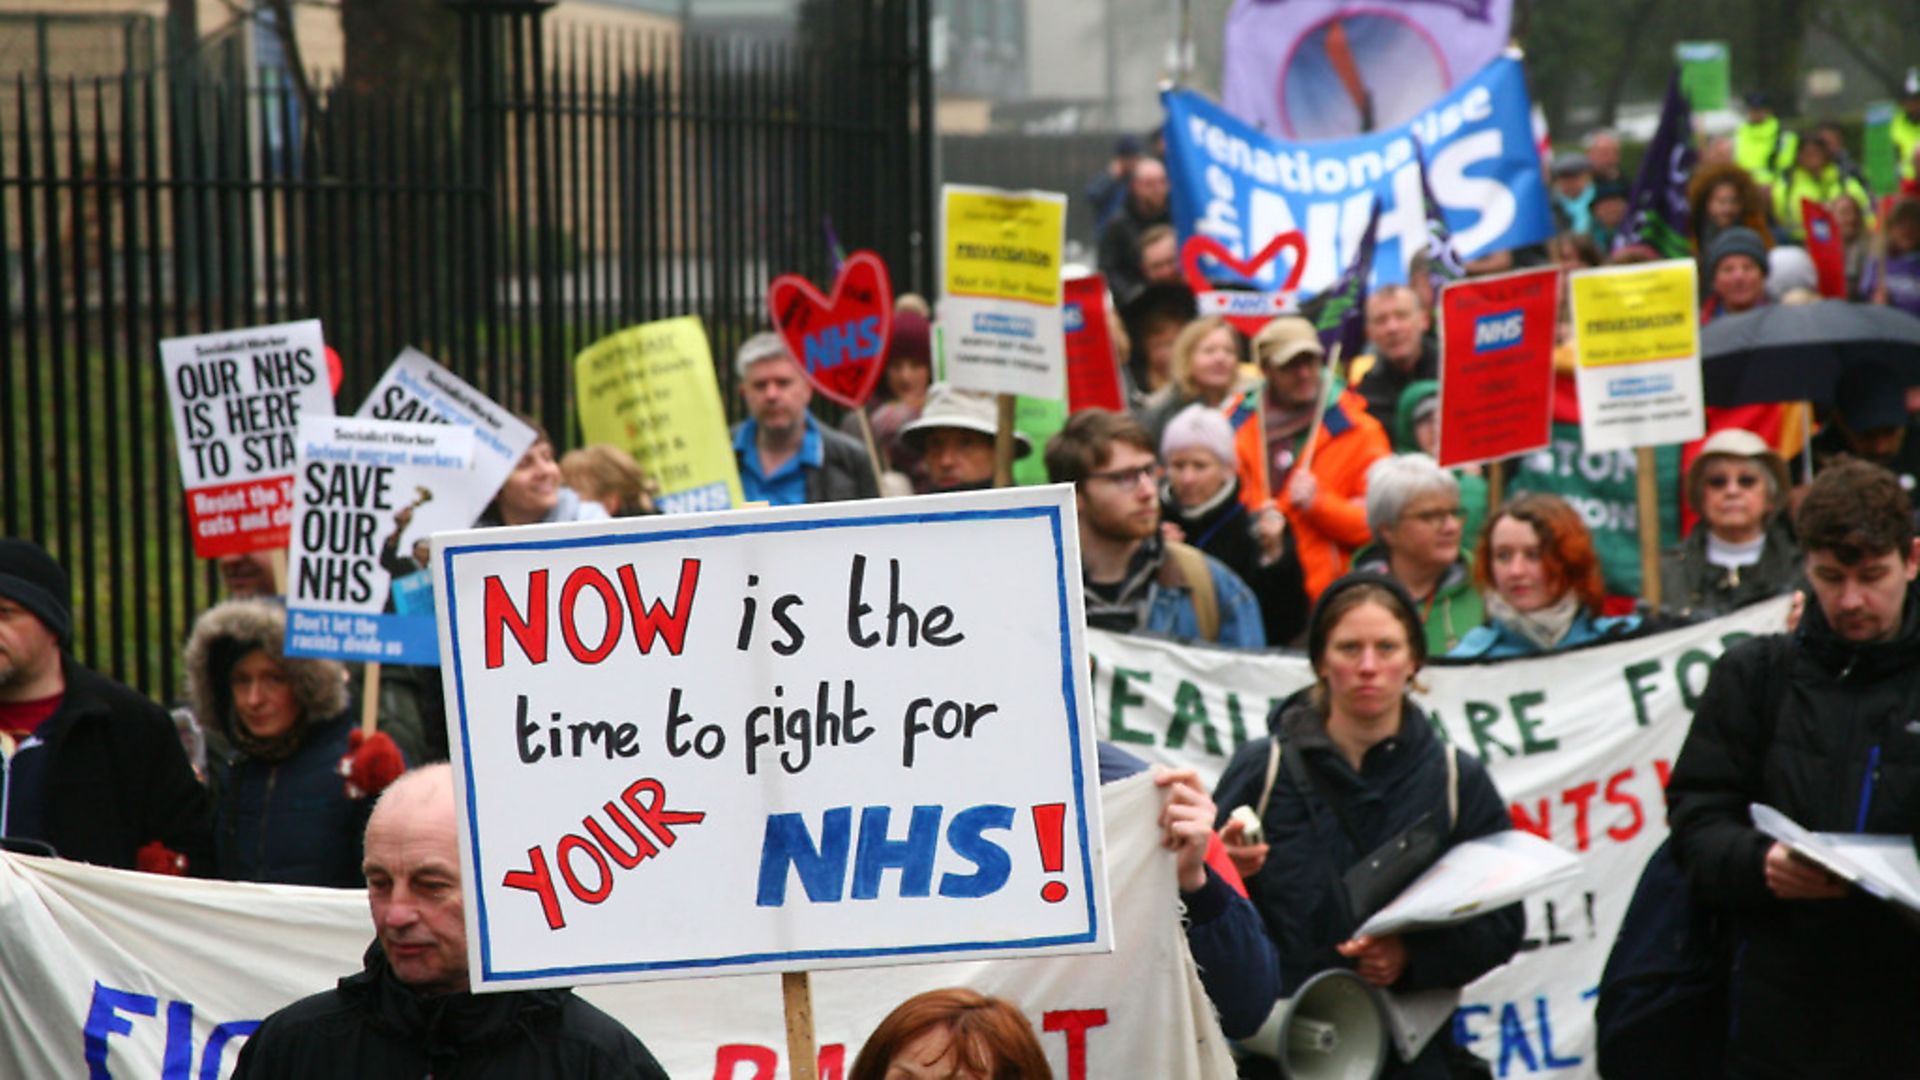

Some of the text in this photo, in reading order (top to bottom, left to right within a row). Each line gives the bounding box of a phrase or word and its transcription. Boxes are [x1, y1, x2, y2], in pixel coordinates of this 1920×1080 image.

[1250, 128, 1518, 296] NHS
[804, 314, 882, 375] NHS
[1475, 315, 1526, 346] NHS
[177, 347, 317, 400] OUR NHS
[182, 391, 302, 440] IS HERE
[371, 384, 453, 425] SA
[190, 431, 297, 478] TO STA
[334, 427, 436, 447] Socialist Worker
[304, 461, 395, 511] SAVE
[302, 509, 377, 556] OUR
[298, 554, 373, 604] NHS
[292, 613, 378, 635] Don't let the
[483, 554, 965, 670] NOW is the
[516, 679, 999, 775] time to fight for
[502, 776, 1069, 931] YOUR NHS!
